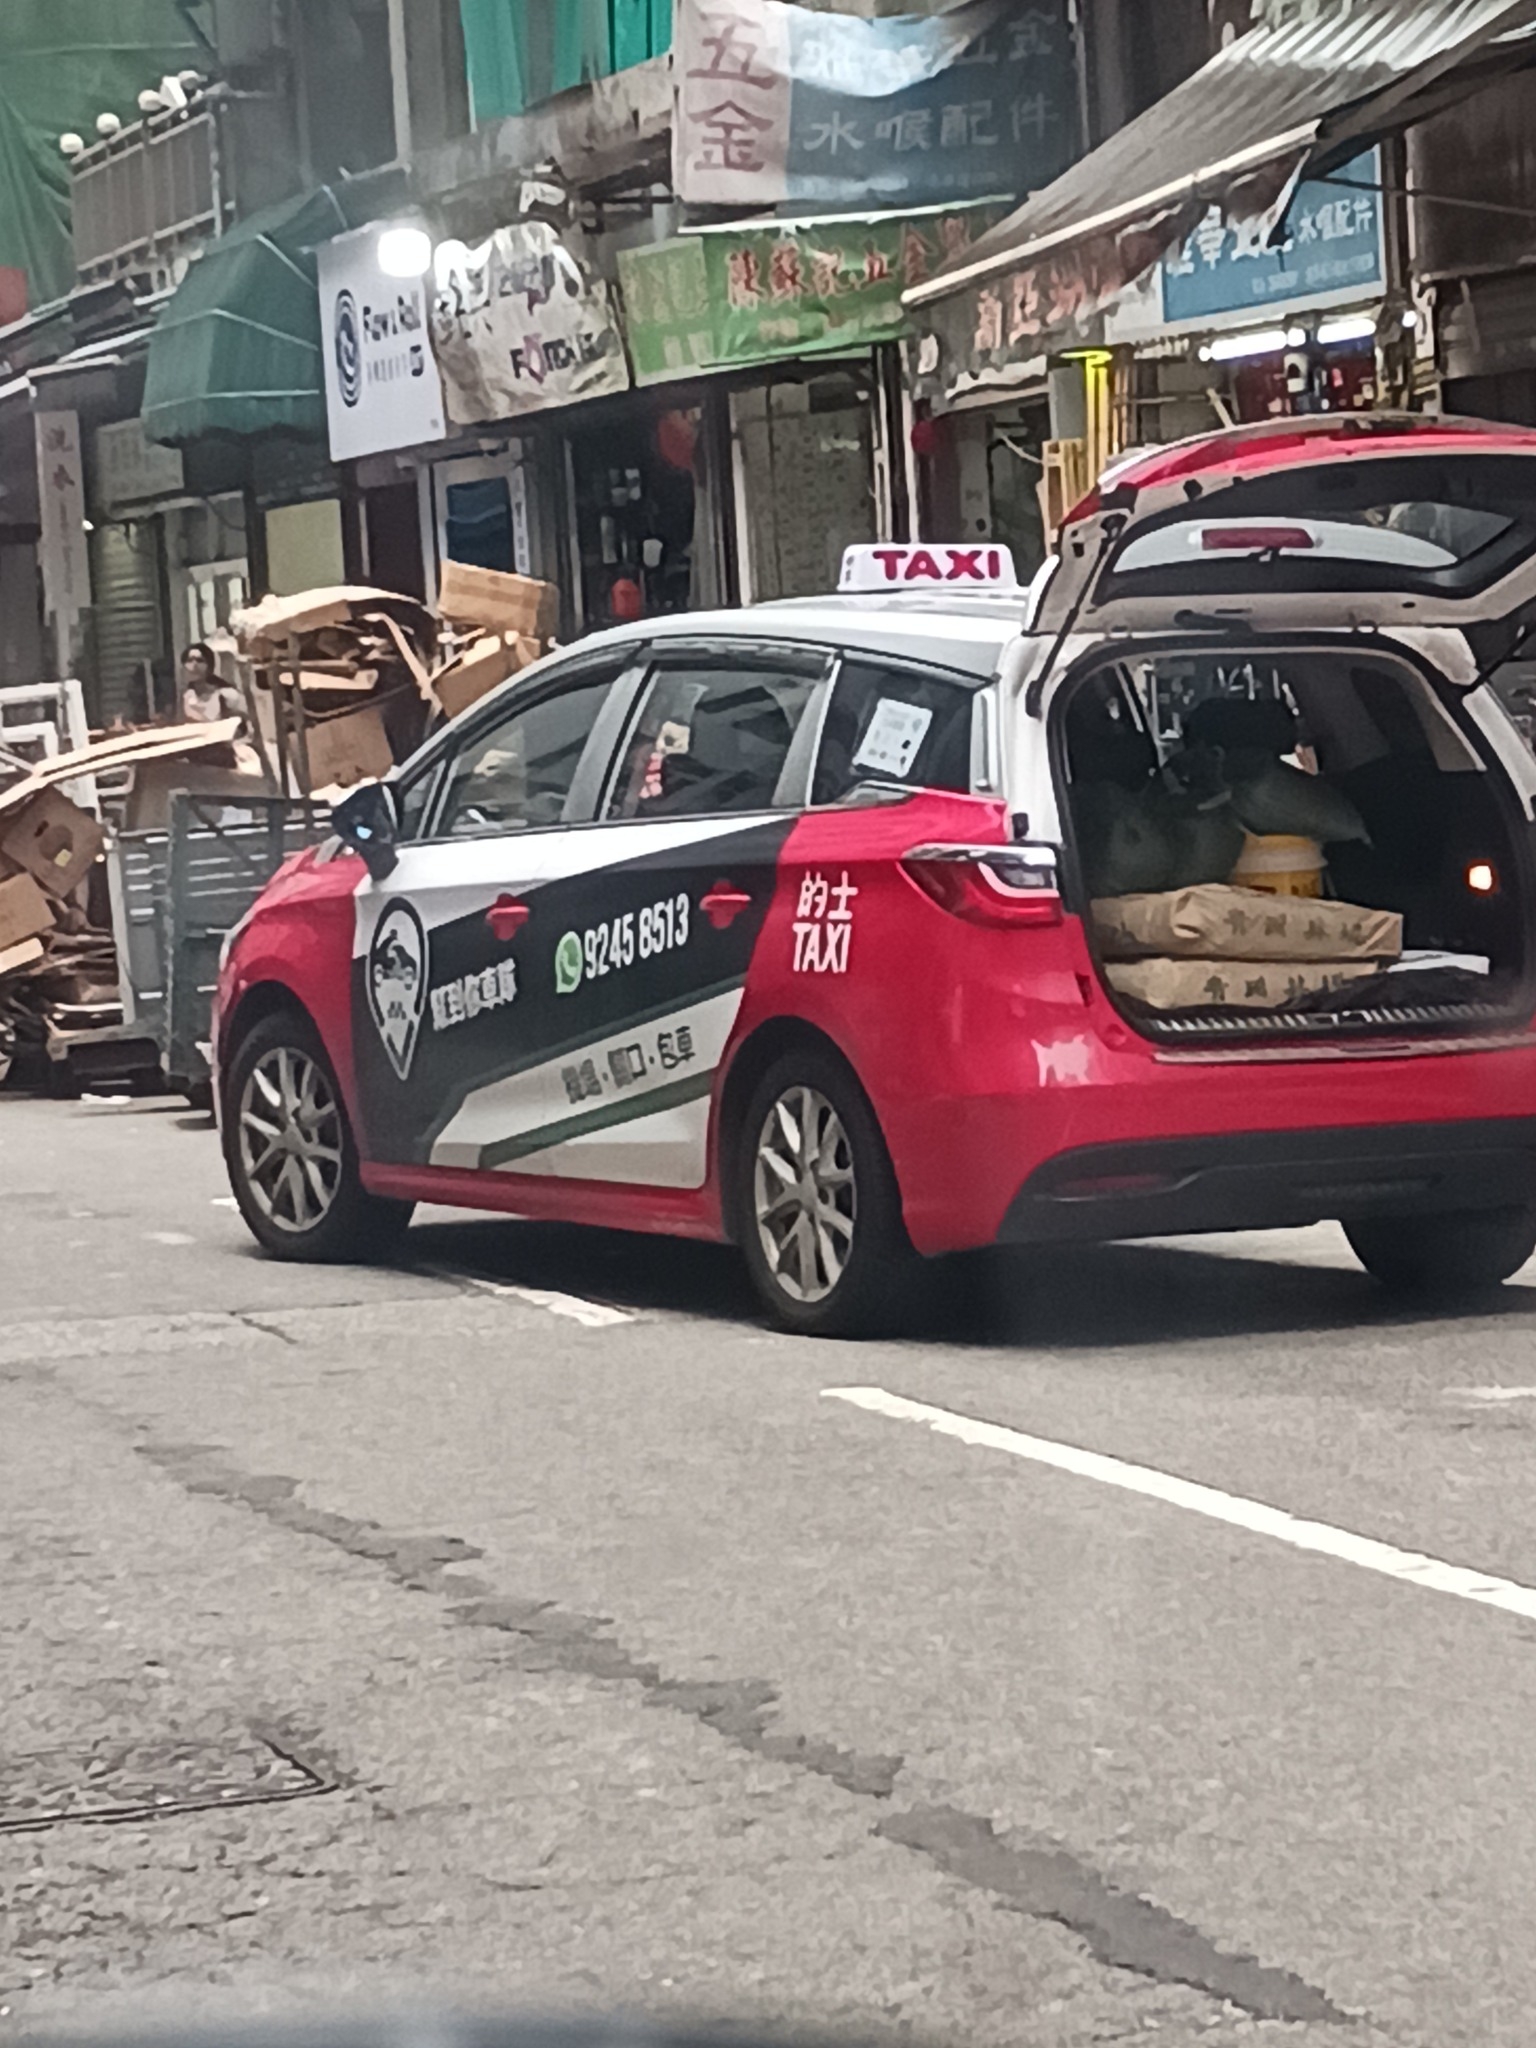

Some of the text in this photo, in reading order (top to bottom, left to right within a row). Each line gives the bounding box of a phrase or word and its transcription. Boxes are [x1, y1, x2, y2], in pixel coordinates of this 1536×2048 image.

[685, 20, 777, 172] 五金
[803, 93, 1061, 156] 水喉配件
[872, 550, 1000, 581] TAXI
[797, 871, 858, 920] 的士
[584, 893, 689, 979] 9245 8513
[792, 922, 853, 974] TAXI
